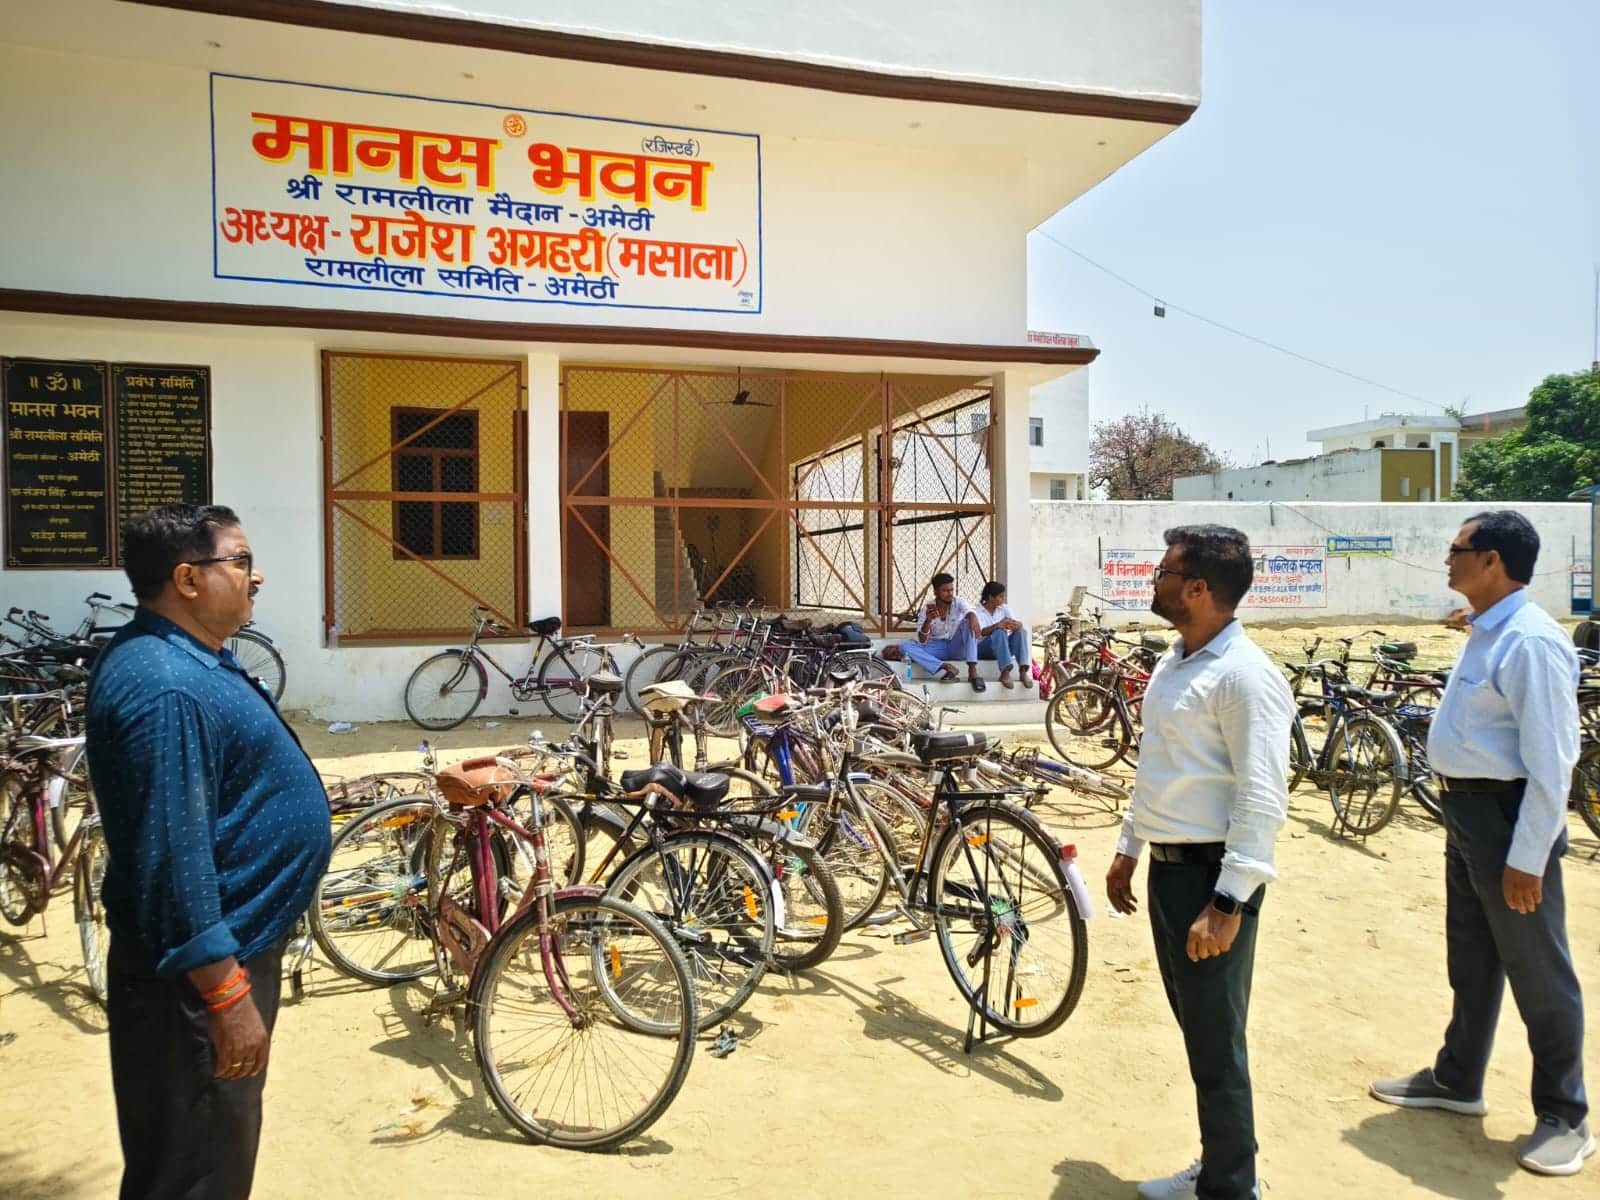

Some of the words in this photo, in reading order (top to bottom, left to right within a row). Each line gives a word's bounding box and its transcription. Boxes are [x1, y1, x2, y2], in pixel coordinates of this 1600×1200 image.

[251, 112, 502, 193] मानस
[527, 142, 714, 211] भवन
[286, 174, 323, 201] श्री
[335, 183, 474, 216] रामलीला
[487, 192, 563, 225] मैदान
[349, 208, 477, 265] राजेश
[486, 226, 609, 275] अग्रहरी
[304, 256, 425, 287] रामलीला
[437, 265, 525, 295] समिति
[545, 271, 620, 300] अमेठी
[125, 374, 156, 389] प्रबंध
[159, 375, 195, 389] समिति
[8, 401, 57, 417] मानस
[62, 403, 102, 419] भवन
[8, 427, 23, 440] श्री
[24, 428, 67, 441] रामलीला
[69, 429, 104, 443] समिति
[66, 449, 102, 462] अमेठी
[1103, 560, 1115, 577] श्री
[1268, 555, 1298, 574] पब्लिक
[1299, 559, 1323, 576] स्कूल
